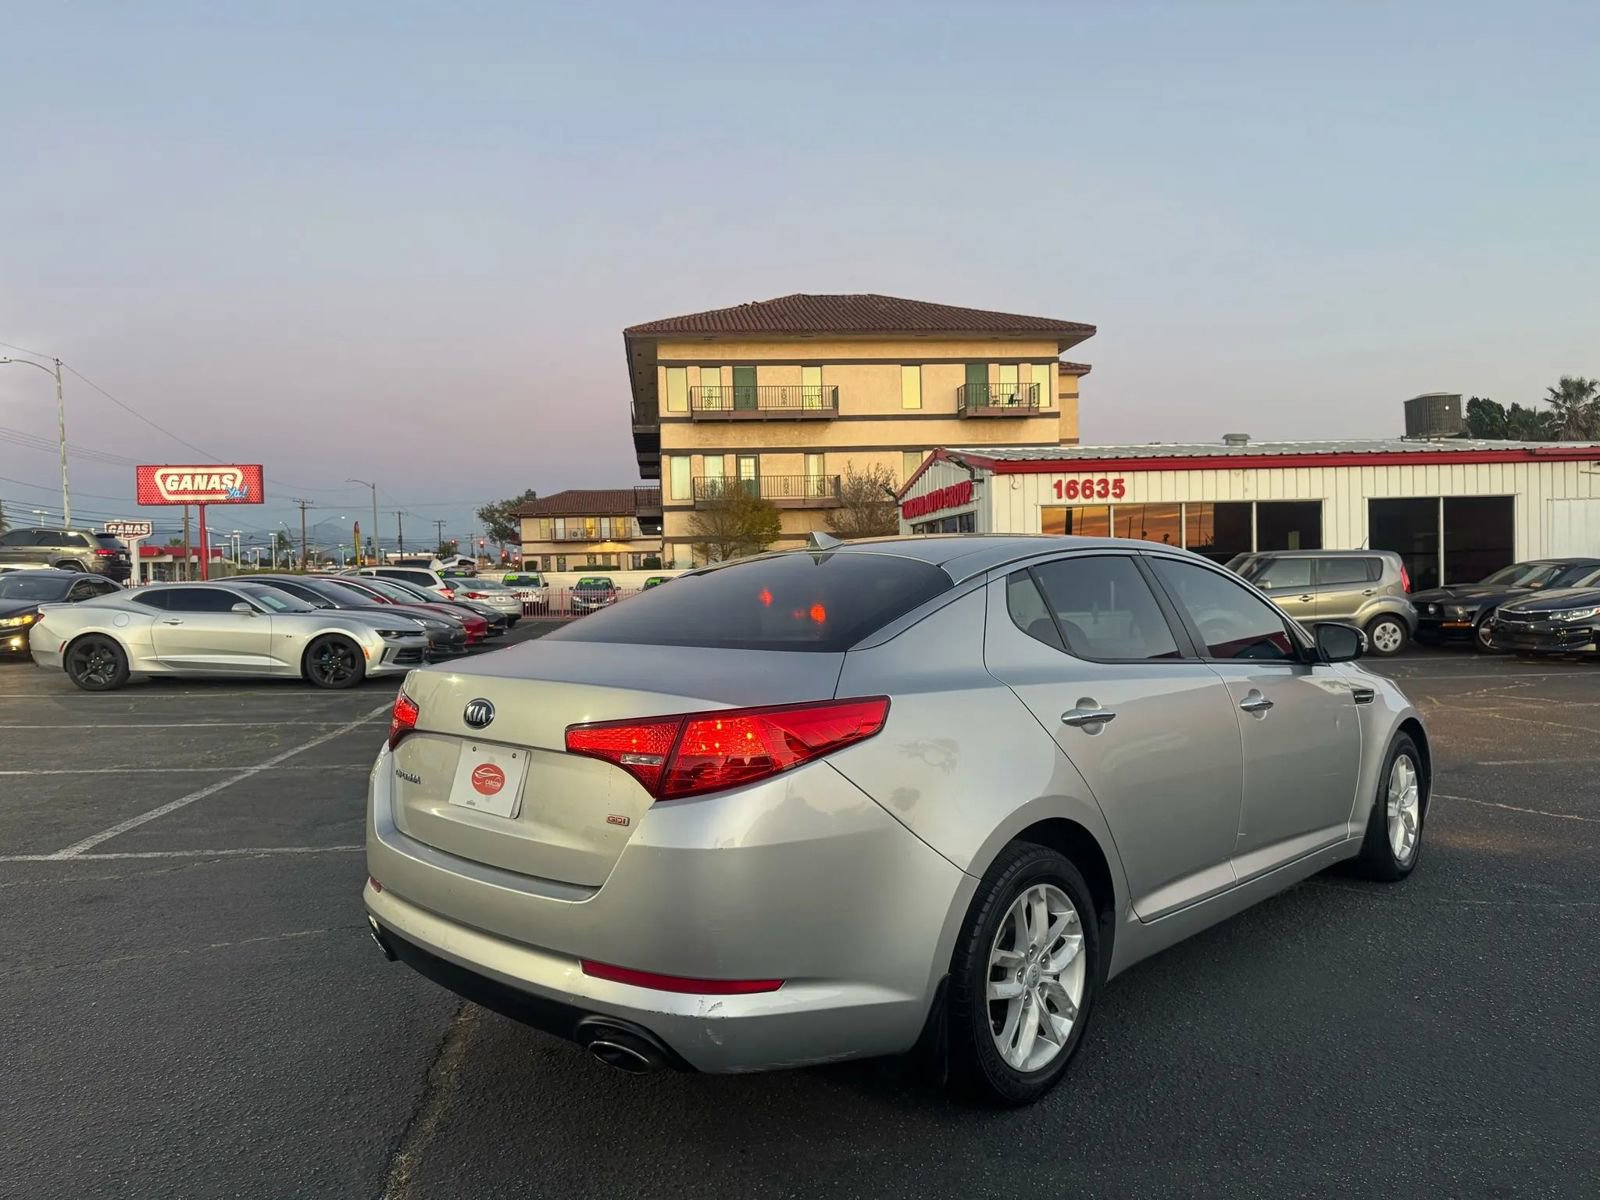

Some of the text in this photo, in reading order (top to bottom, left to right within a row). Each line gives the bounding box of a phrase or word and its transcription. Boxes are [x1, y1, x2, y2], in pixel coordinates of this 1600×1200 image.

[165, 474, 235, 491] GANAS
[1053, 478, 1125, 500] 16635
[925, 488, 945, 514] AUTO
[944, 479, 973, 508] GROUP
[107, 523, 149, 535] GANAS
[465, 704, 487, 723] KIA
